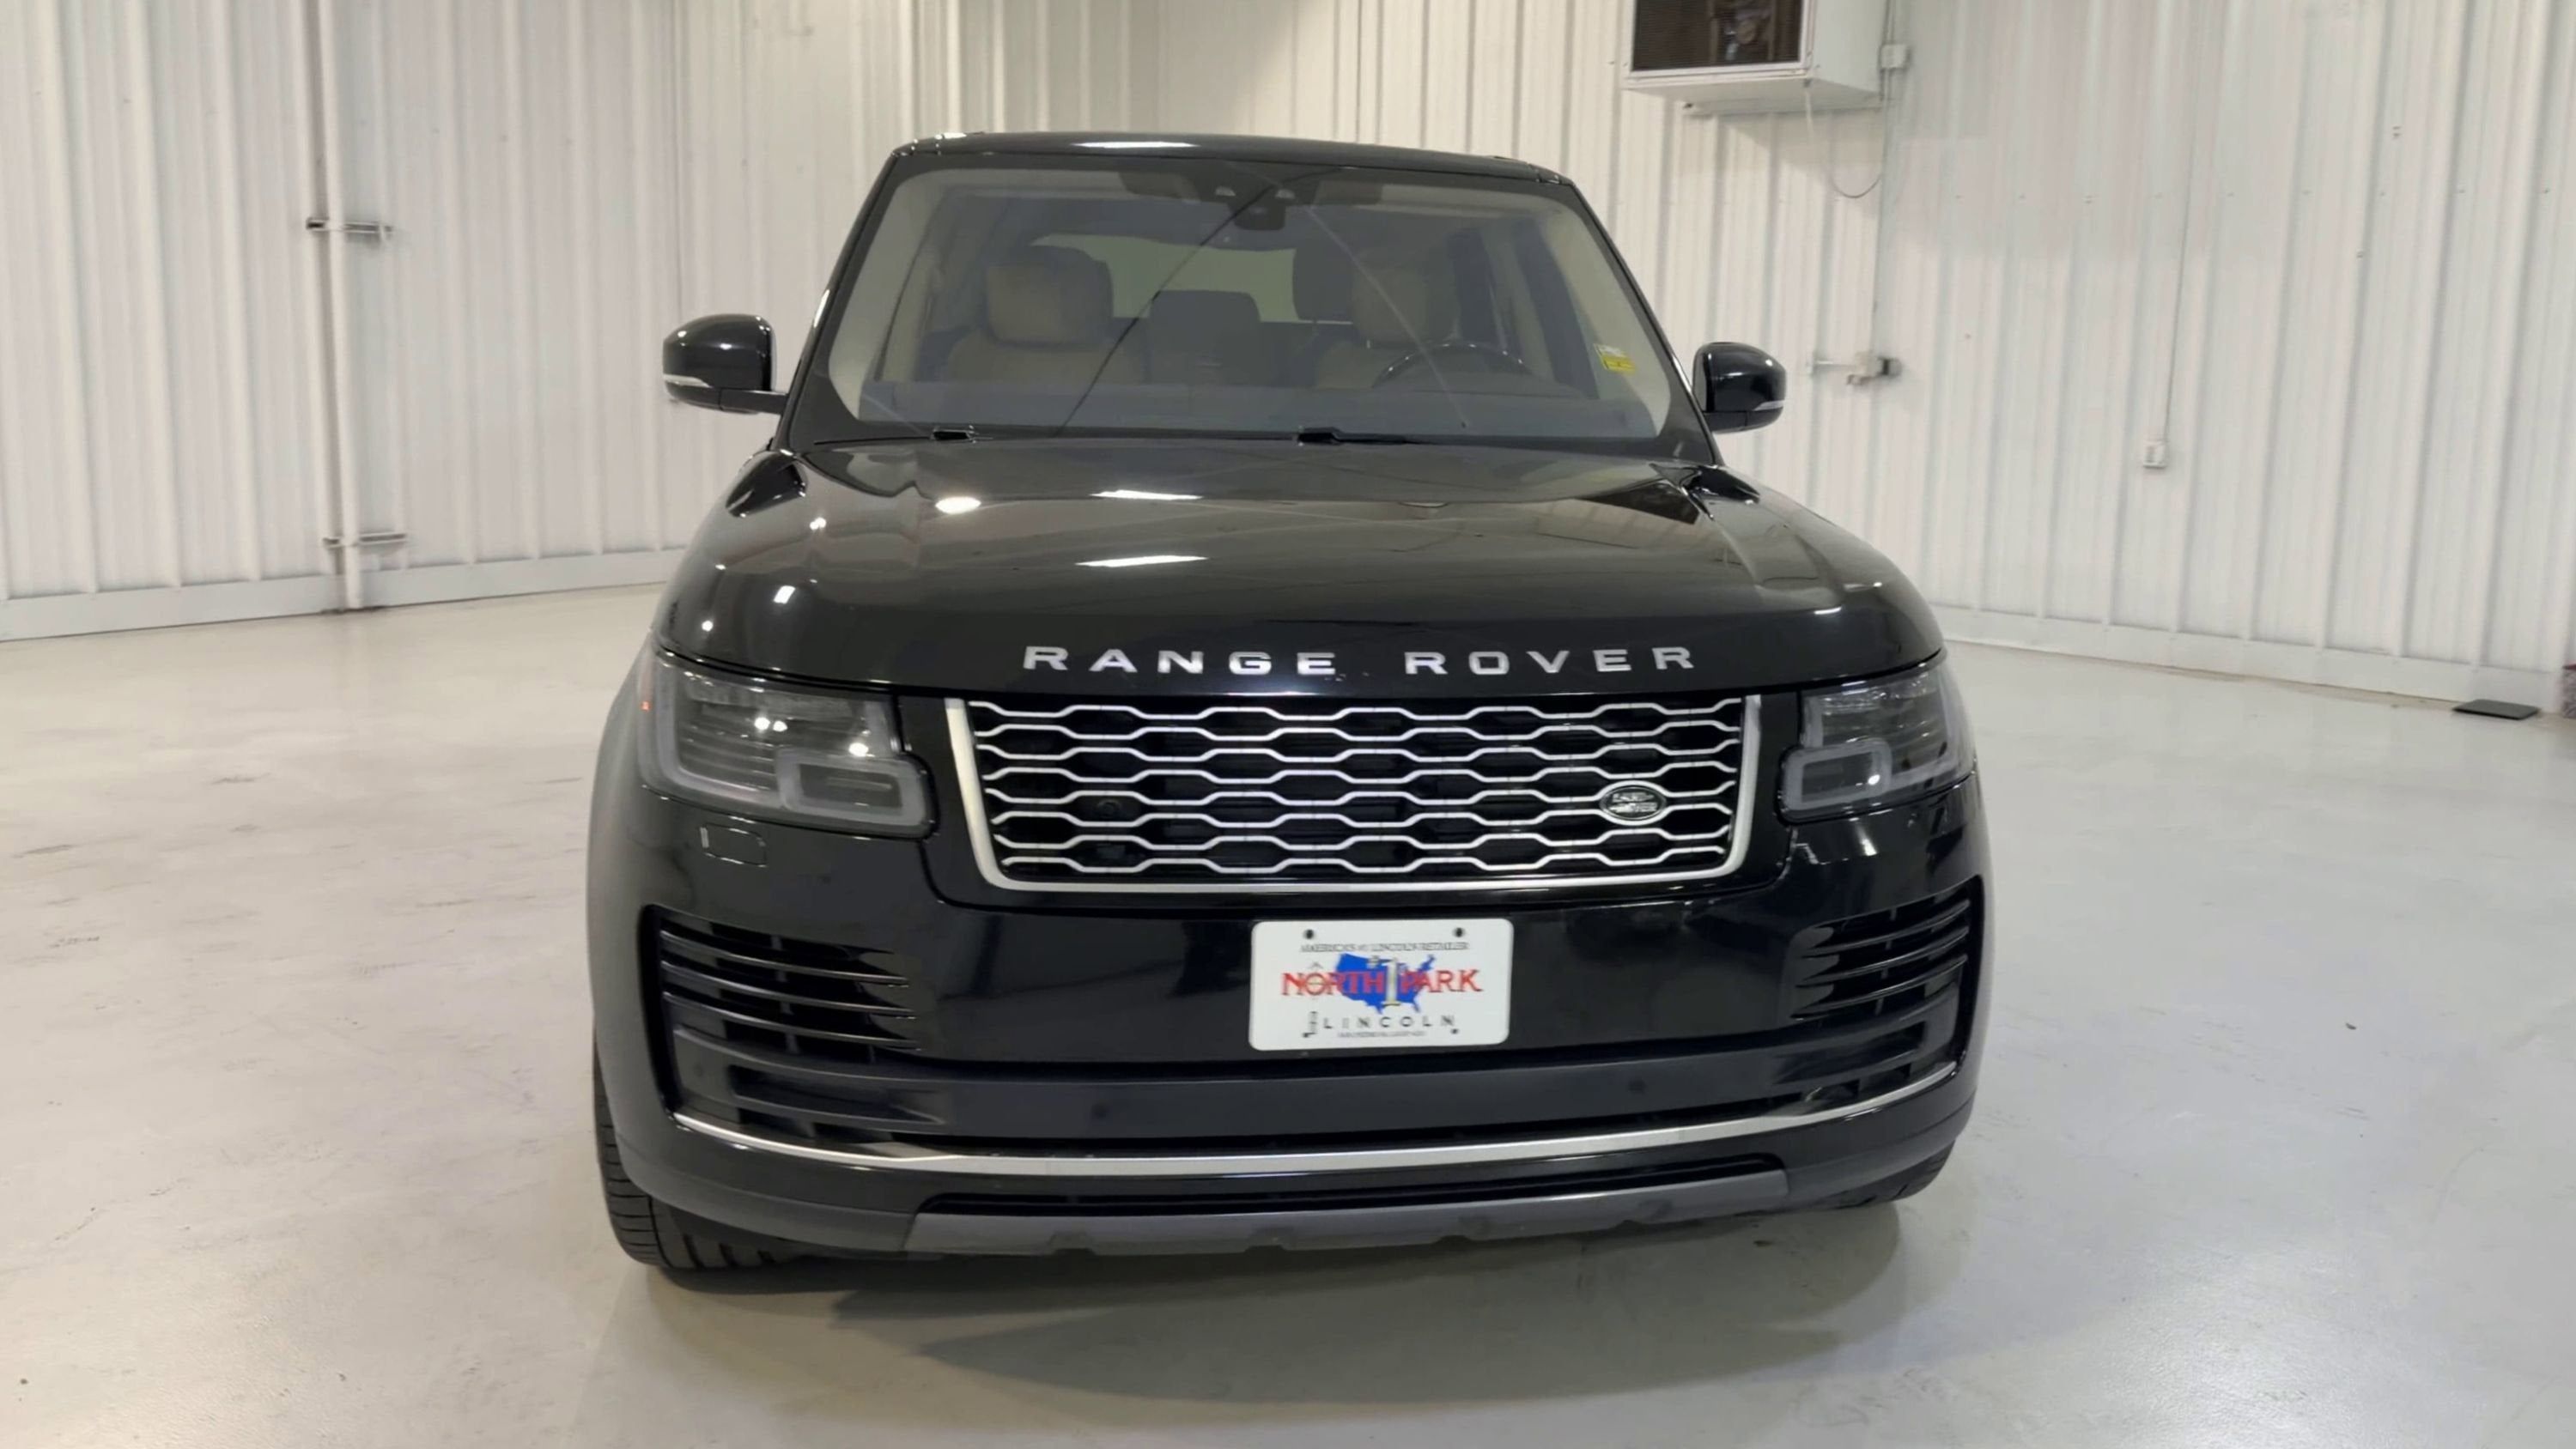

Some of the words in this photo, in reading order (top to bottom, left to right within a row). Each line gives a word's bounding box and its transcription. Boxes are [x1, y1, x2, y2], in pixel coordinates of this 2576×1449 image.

[1023, 646, 1336, 676] RANGE
[1404, 646, 1694, 676] ROVER
[1282, 972, 1385, 996] NORTH
[1400, 969, 1483, 994] PARK
[1323, 1015, 1455, 1029] LINCOLN
